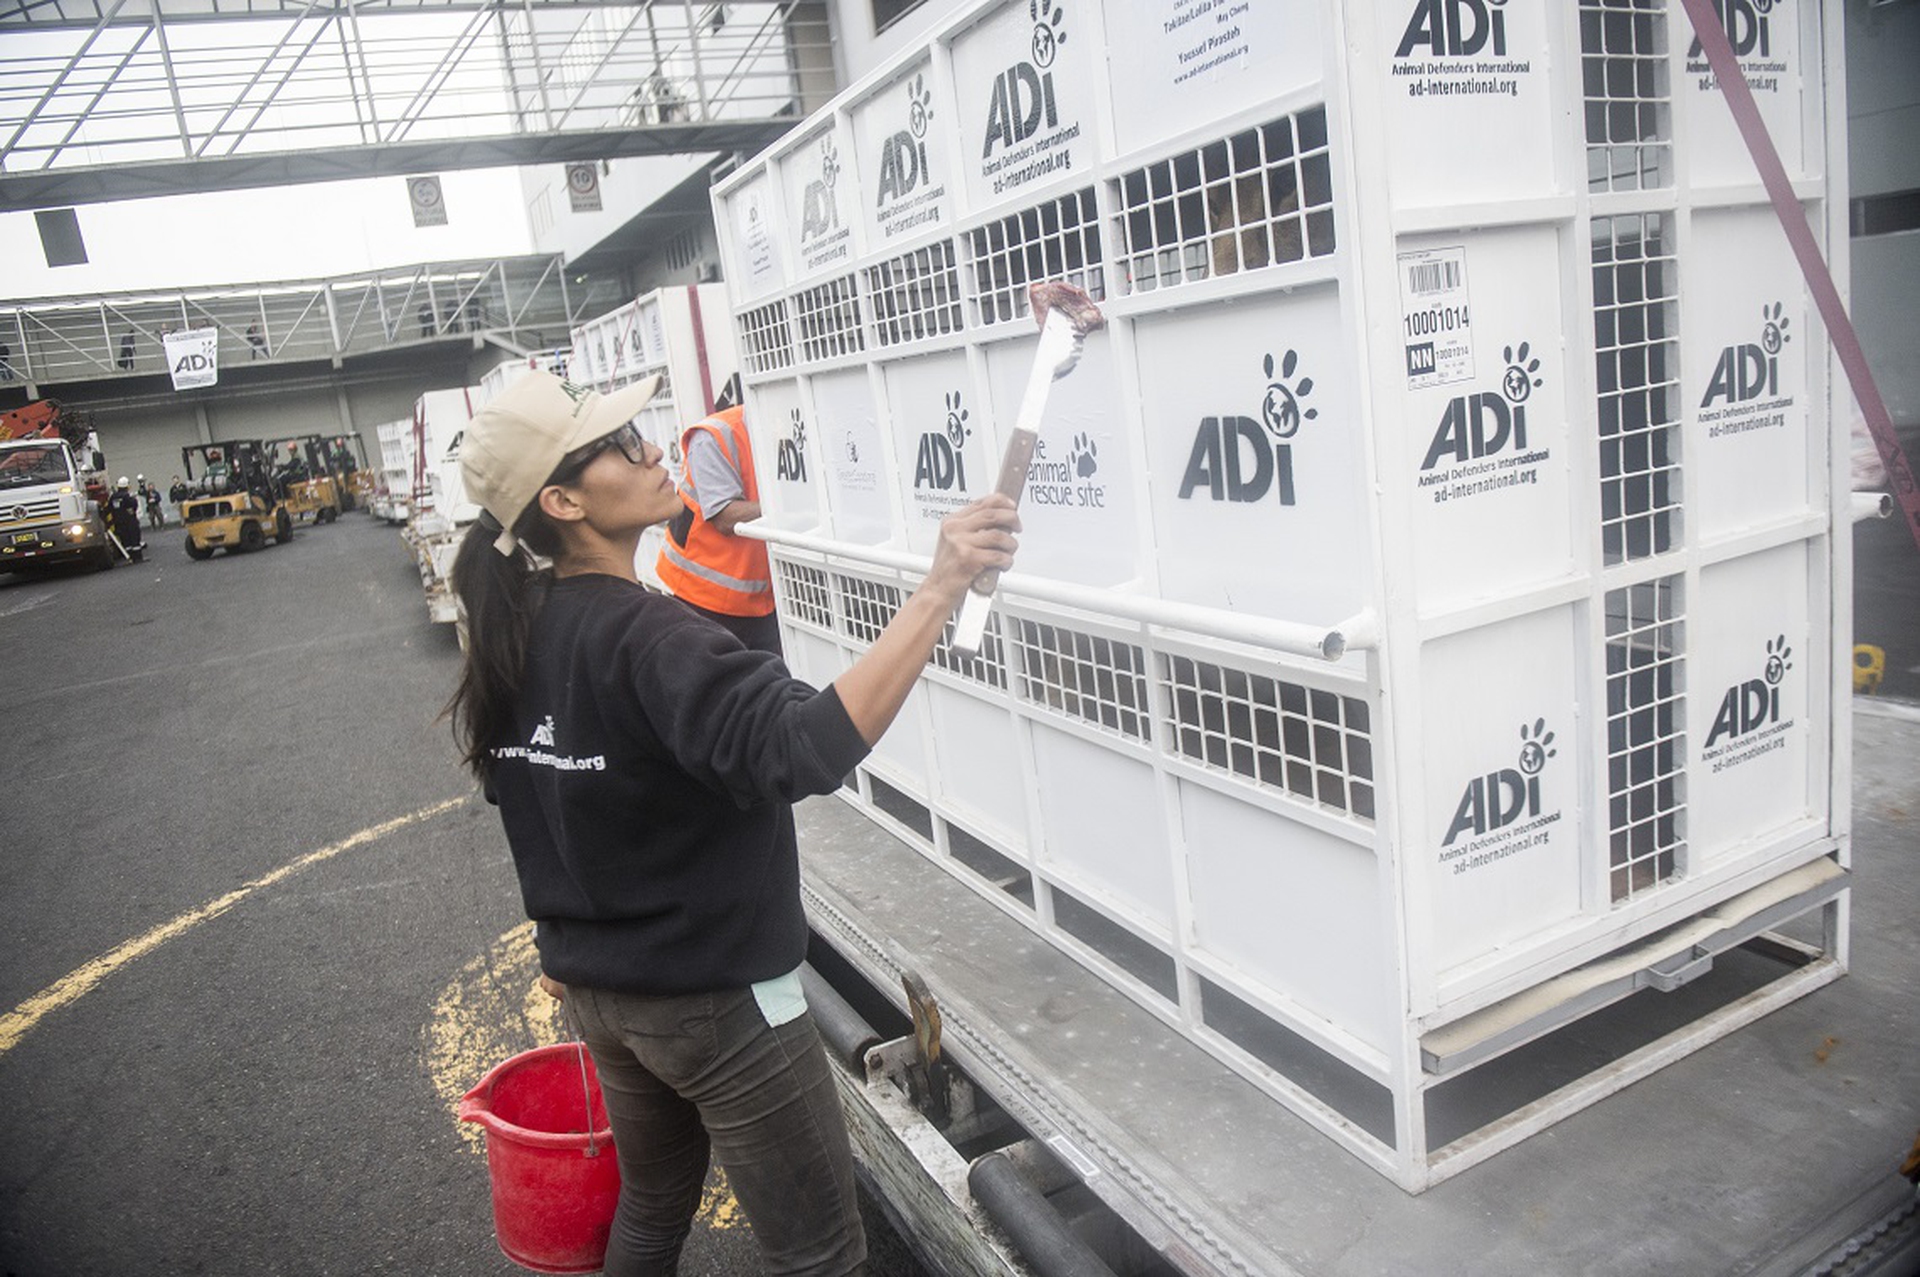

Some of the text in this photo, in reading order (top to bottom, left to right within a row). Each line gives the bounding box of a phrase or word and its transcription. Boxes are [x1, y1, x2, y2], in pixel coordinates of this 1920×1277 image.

[1392, 61, 1530, 75] Animal Defenders International
[1409, 78, 1518, 97] ad-international.org
[993, 149, 1071, 195] ad-international.org
[1404, 305, 1469, 337] 10001014
[1410, 347, 1433, 370] NN
[1709, 413, 1784, 438] ad-international.org
[1418, 448, 1550, 487] Animal Defenders International
[1029, 485, 1073, 506] rescue
[1434, 468, 1537, 503] ad-international.org
[1438, 810, 1561, 863] Animal Defenders International
[1453, 831, 1550, 875] ad-international.org
